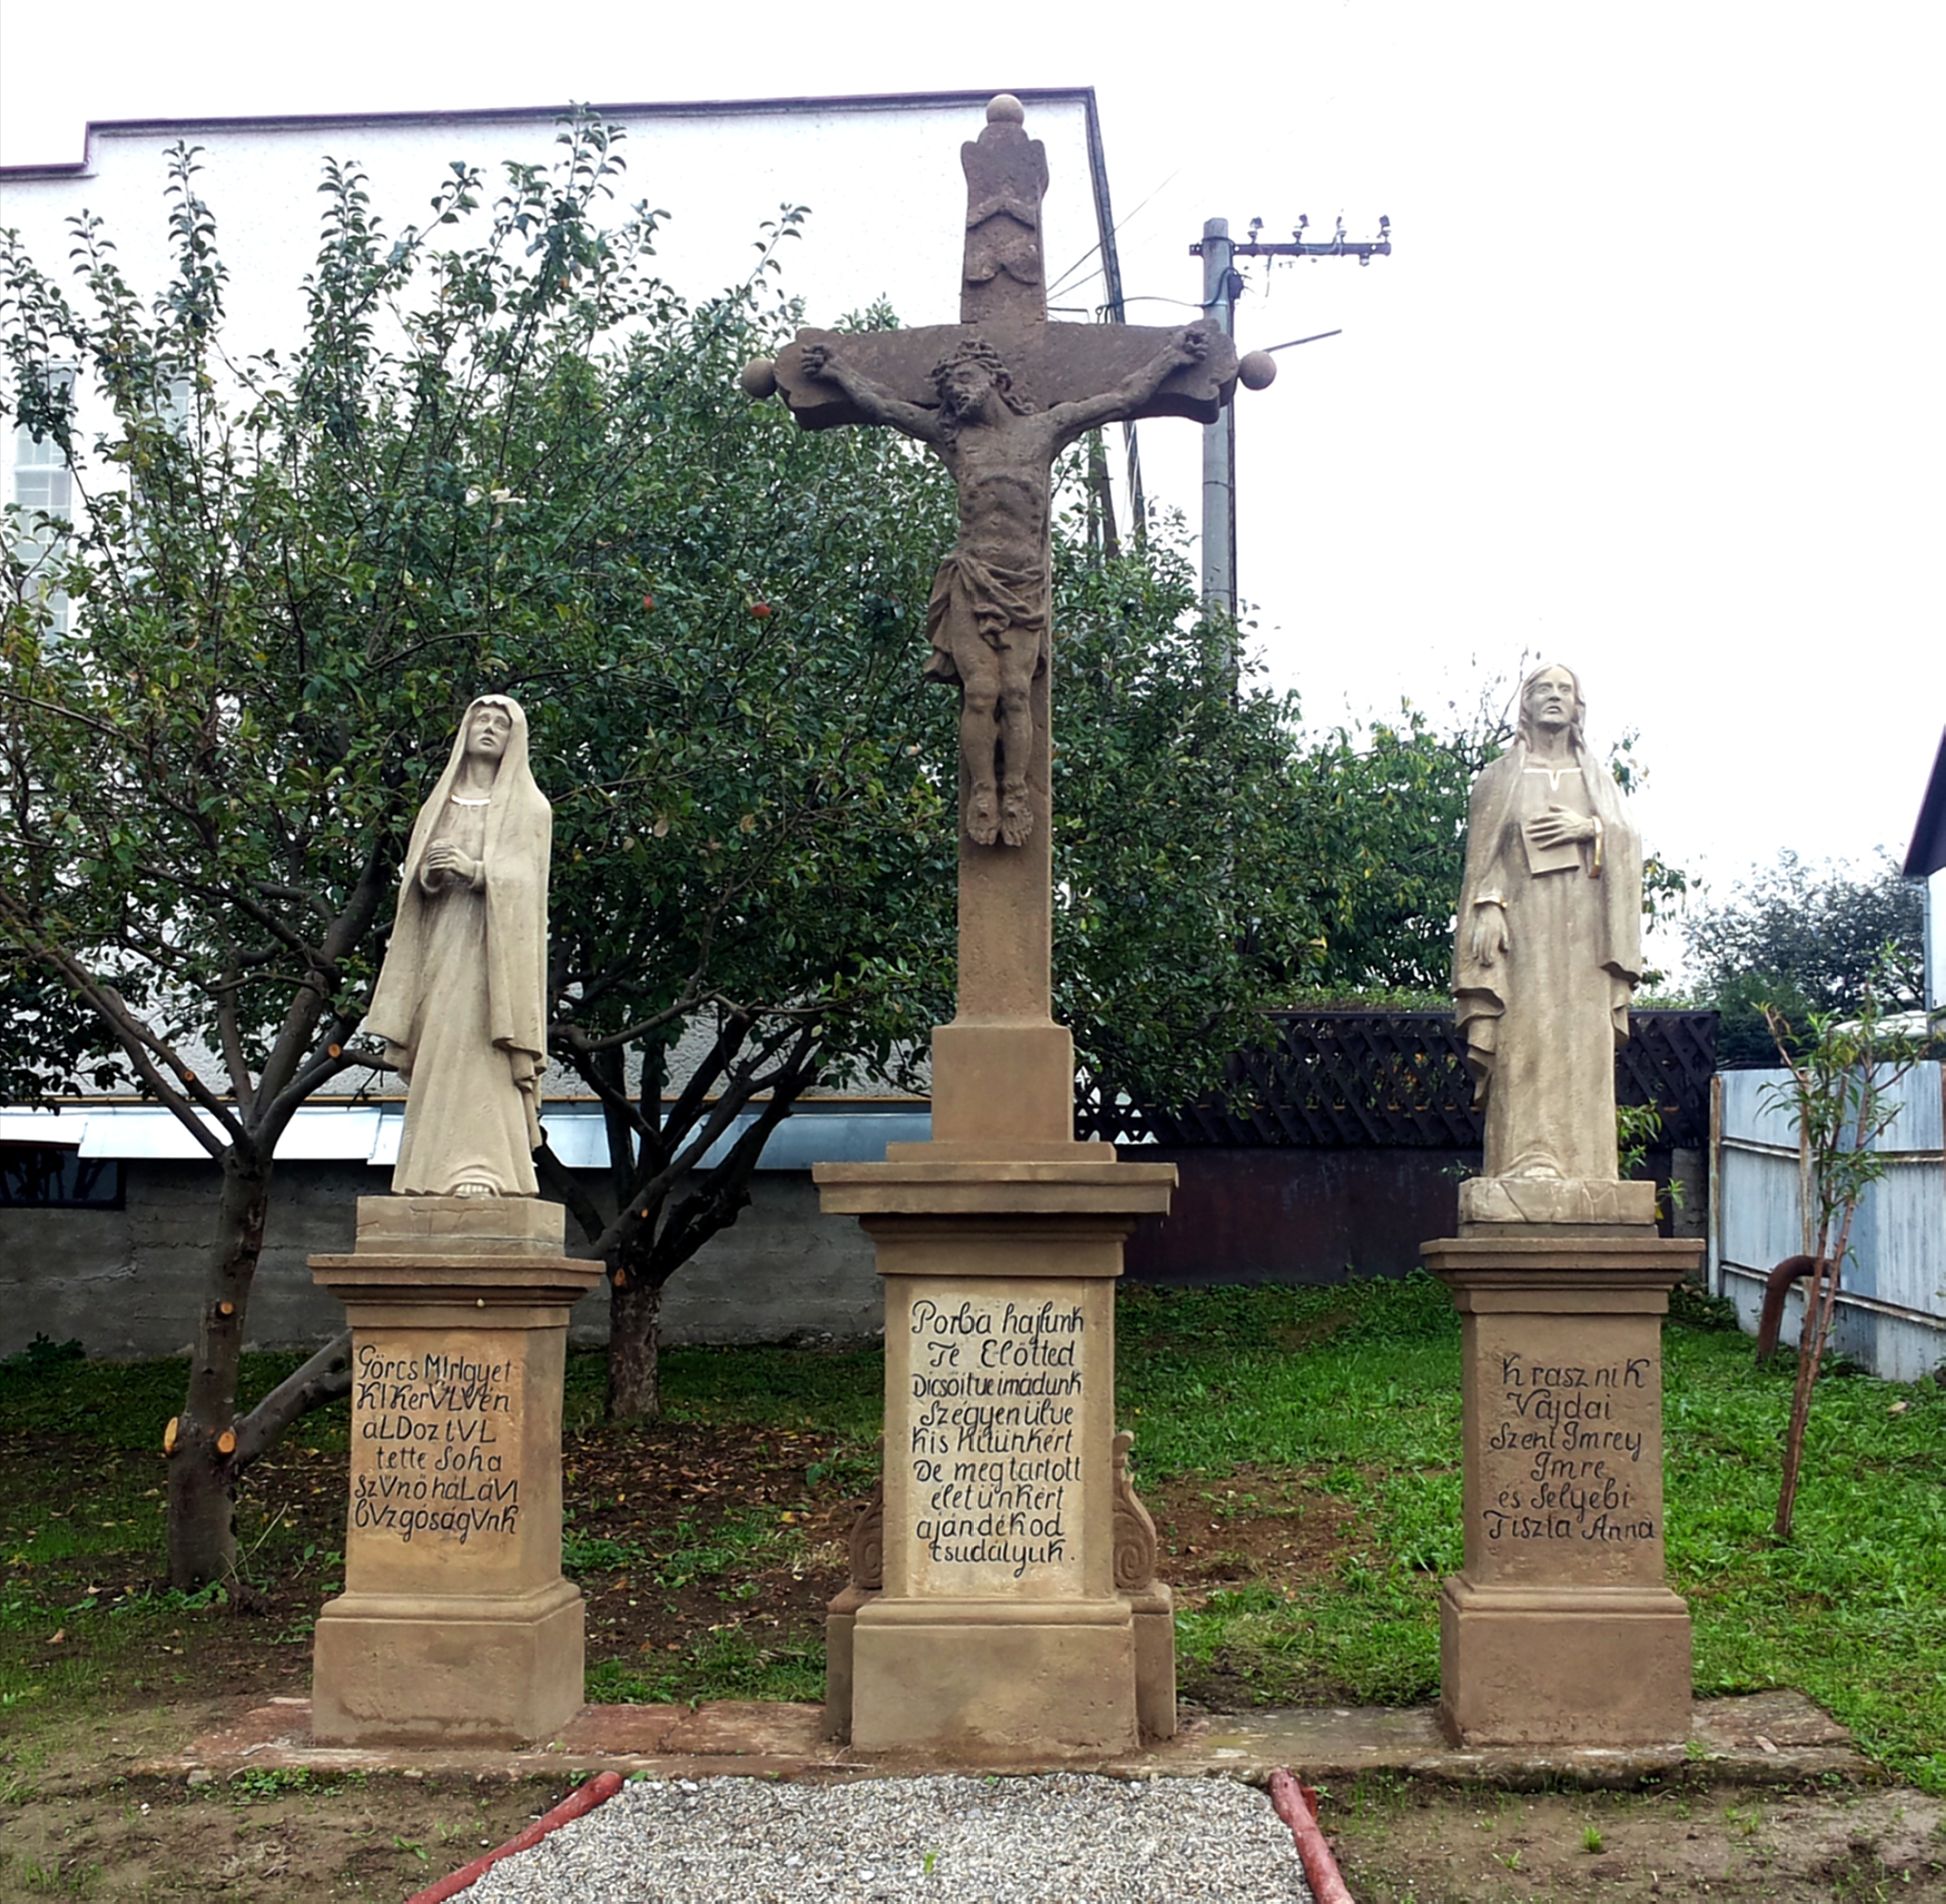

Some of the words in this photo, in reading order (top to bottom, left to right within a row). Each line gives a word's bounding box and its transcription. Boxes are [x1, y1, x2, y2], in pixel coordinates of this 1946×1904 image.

[911, 1300, 992, 1334] Porba
[359, 1345, 419, 1381] Görcs
[928, 1341, 960, 1368] Te
[1506, 1389, 1611, 1430] Vajdai
[1490, 1422, 1556, 1450] Szent
[377, 1446, 426, 1470] tette
[913, 1459, 943, 1482] De
[1530, 1452, 1606, 1481] Imre
[1498, 1485, 1520, 1509] és
[1483, 1510, 1572, 1540] Tiszta
[1582, 1514, 1655, 1542] Anna
